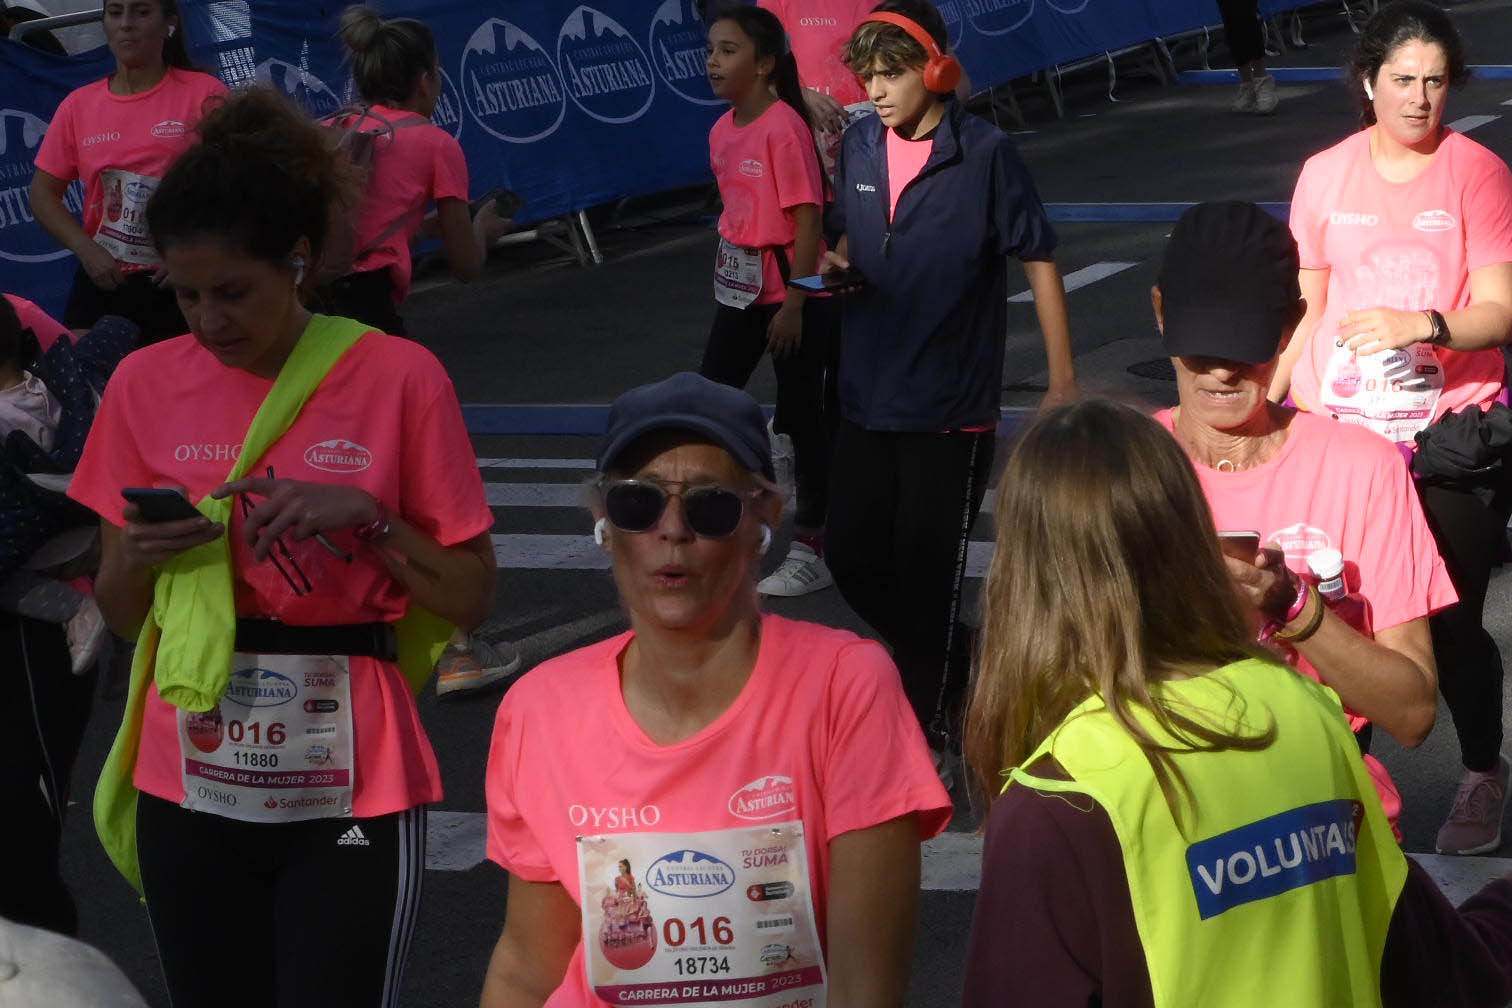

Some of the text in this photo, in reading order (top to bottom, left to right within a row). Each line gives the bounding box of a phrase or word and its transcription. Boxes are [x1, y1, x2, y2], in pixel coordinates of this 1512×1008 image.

[566, 53, 651, 99] ASTURIANA
[470, 70, 563, 117] ASTURIANA
[306, 449, 370, 468] ASTURIANA
[226, 683, 291, 698] ASTURIANA
[304, 678, 336, 688] SUMA
[228, 719, 287, 746] 016
[233, 751, 279, 768] 11880
[199, 765, 334, 785] CARRERA DE LA MUJER 2023
[197, 786, 238, 806] OYSHO
[278, 796, 339, 809] Santander
[568, 804, 661, 829] OYSHO
[337, 834, 370, 847] adidas
[742, 852, 789, 870] SUMA
[653, 871, 730, 887] ASTURIANA
[662, 916, 735, 948] 016
[673, 956, 731, 976] 18734
[618, 975, 802, 1002] CARRERA DE LA MUJER 2023
